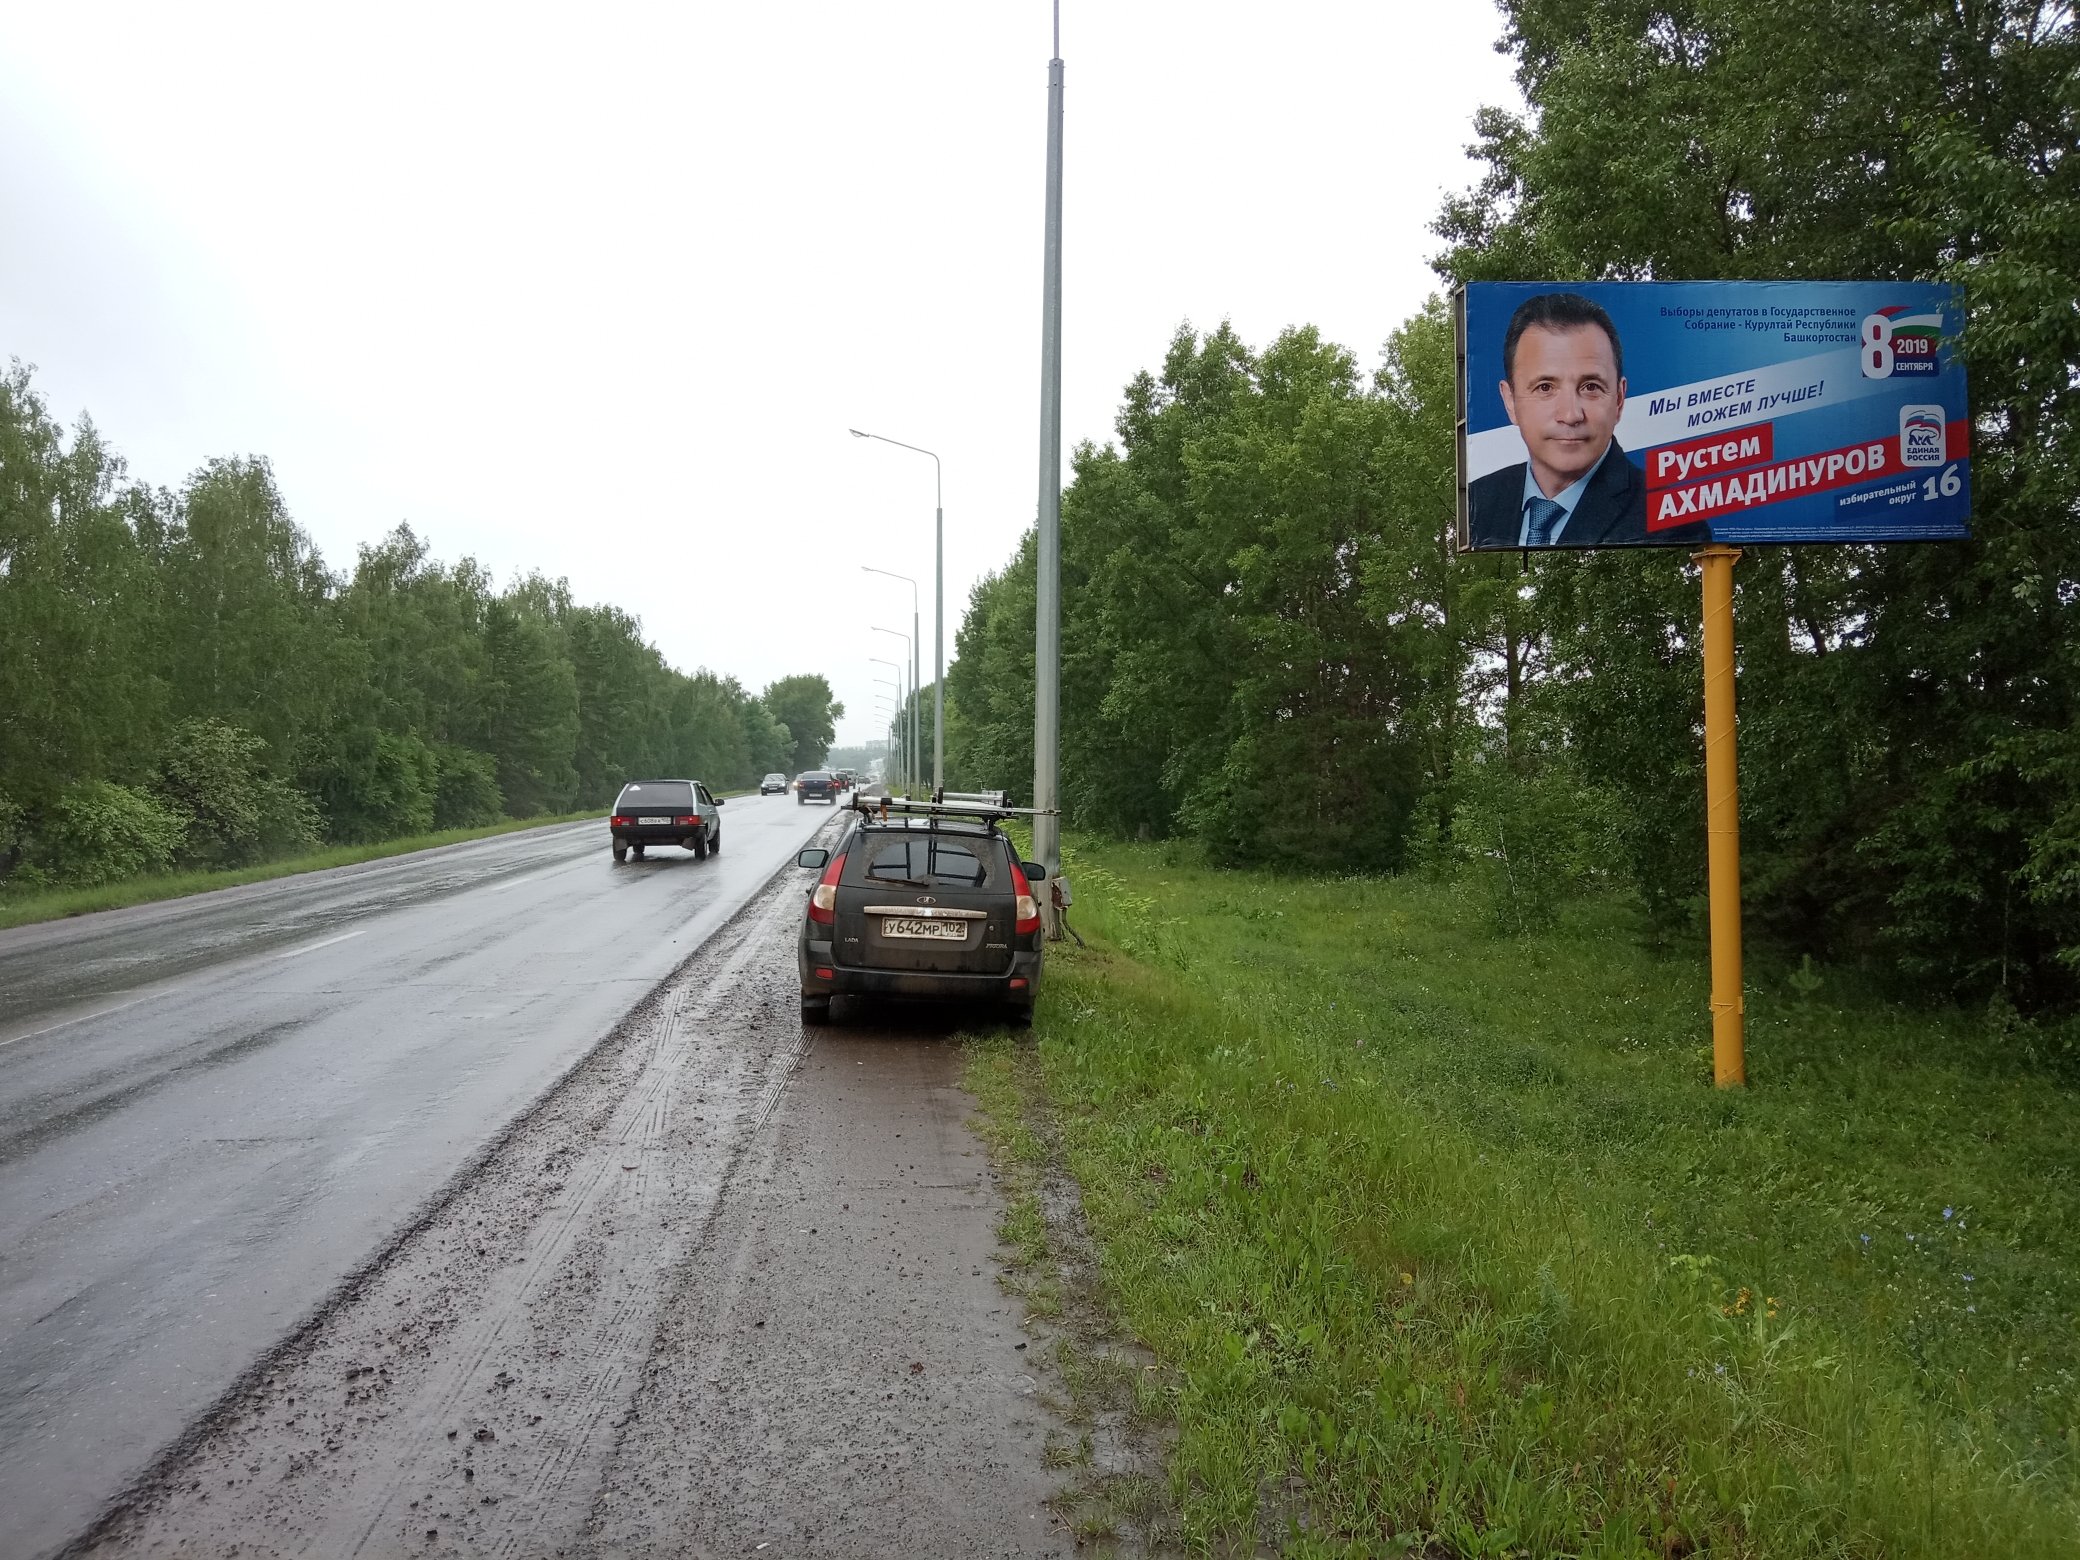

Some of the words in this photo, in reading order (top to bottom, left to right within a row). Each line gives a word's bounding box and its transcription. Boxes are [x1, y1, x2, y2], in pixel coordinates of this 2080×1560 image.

[1661, 307, 1704, 318] Выборы
[1707, 308, 1759, 318] депутатов
[1761, 308, 1768, 316] в
[1770, 306, 1856, 319] Государственное
[1685, 320, 1736, 330] Собрание
[1745, 319, 1793, 331] Курултай
[1796, 319, 1856, 331] Республики
[1783, 333, 1856, 344] Башкортостан
[1861, 314, 1894, 379] 8
[1897, 339, 1928, 354] 2019
[1896, 362, 1933, 371] СЕНТЯБРЯ
[1658, 435, 1761, 481] Рустем
[1657, 444, 1885, 521] АХМАДИНУРОВ
[1922, 463, 1961, 502] 16
[1840, 480, 1916, 506] избирательный
[1889, 492, 1916, 506] округ
